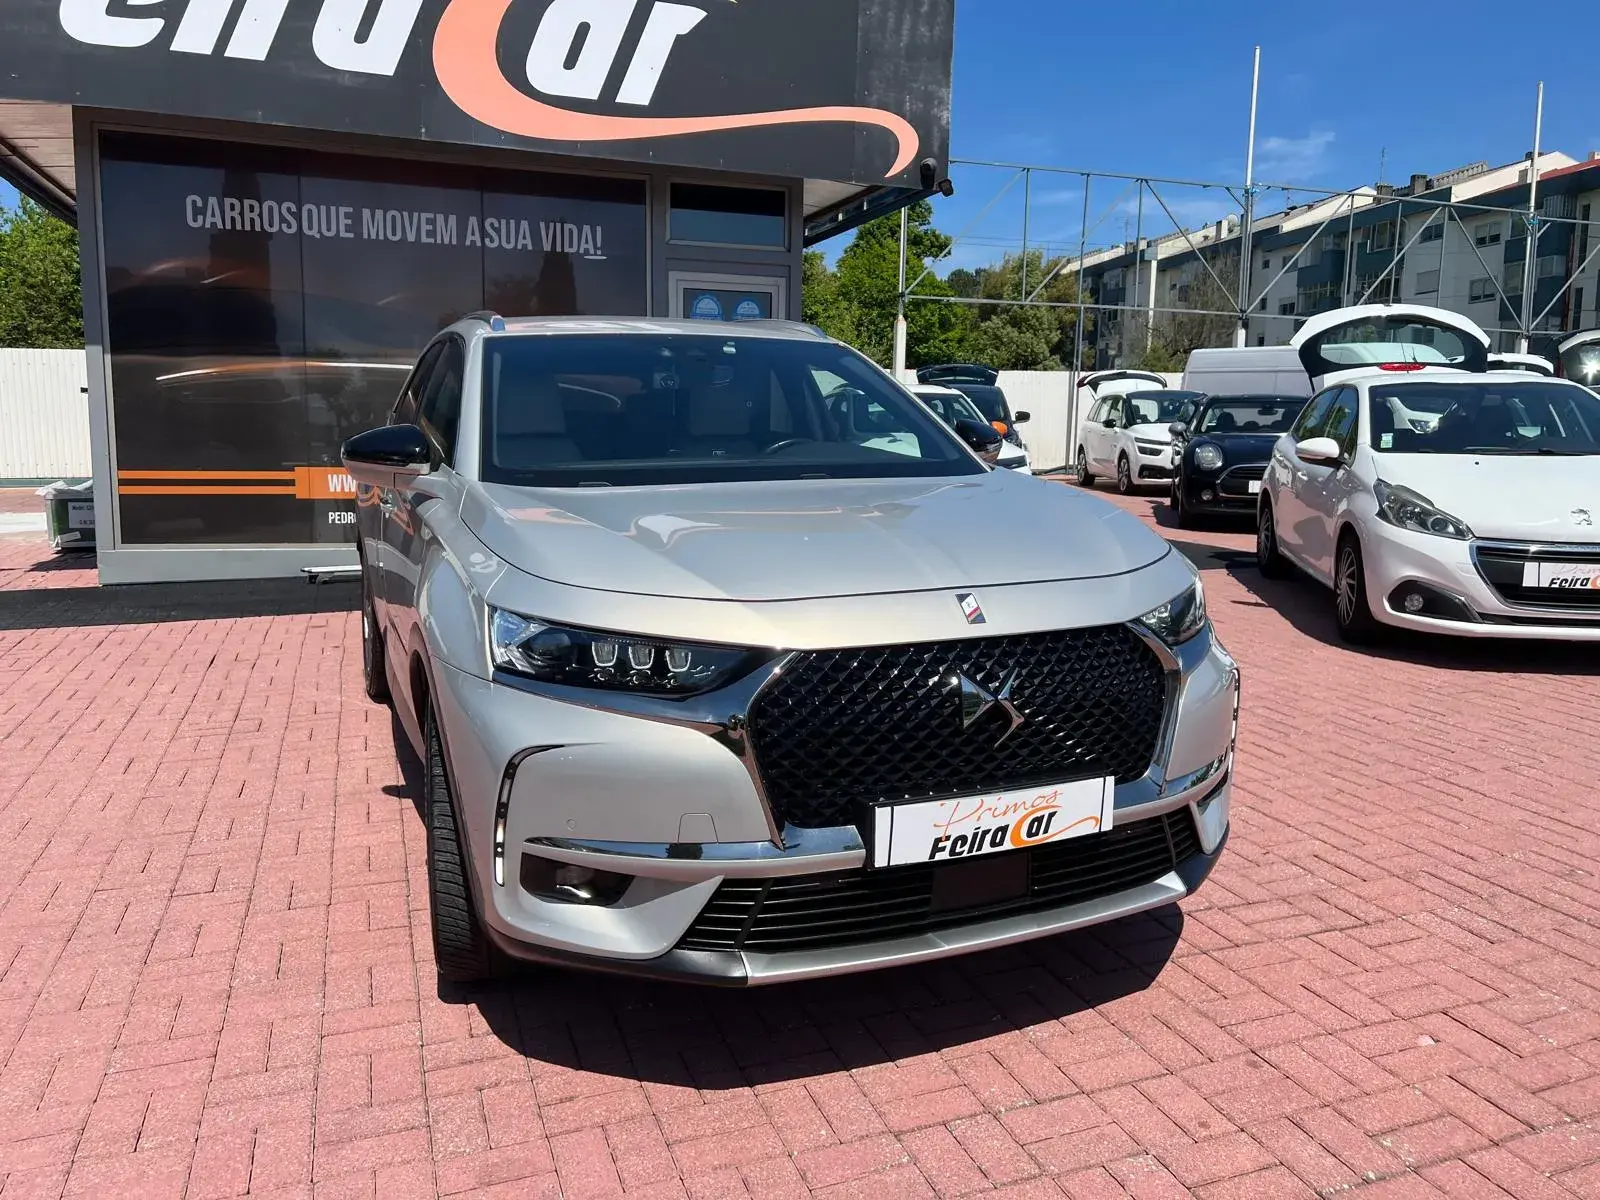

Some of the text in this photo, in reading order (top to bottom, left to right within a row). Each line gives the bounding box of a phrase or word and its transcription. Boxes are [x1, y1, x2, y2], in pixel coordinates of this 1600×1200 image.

[185, 194, 603, 256] CARROS QUE MOVEM A SUA VIDA!
[933, 789, 1063, 842] Primos
